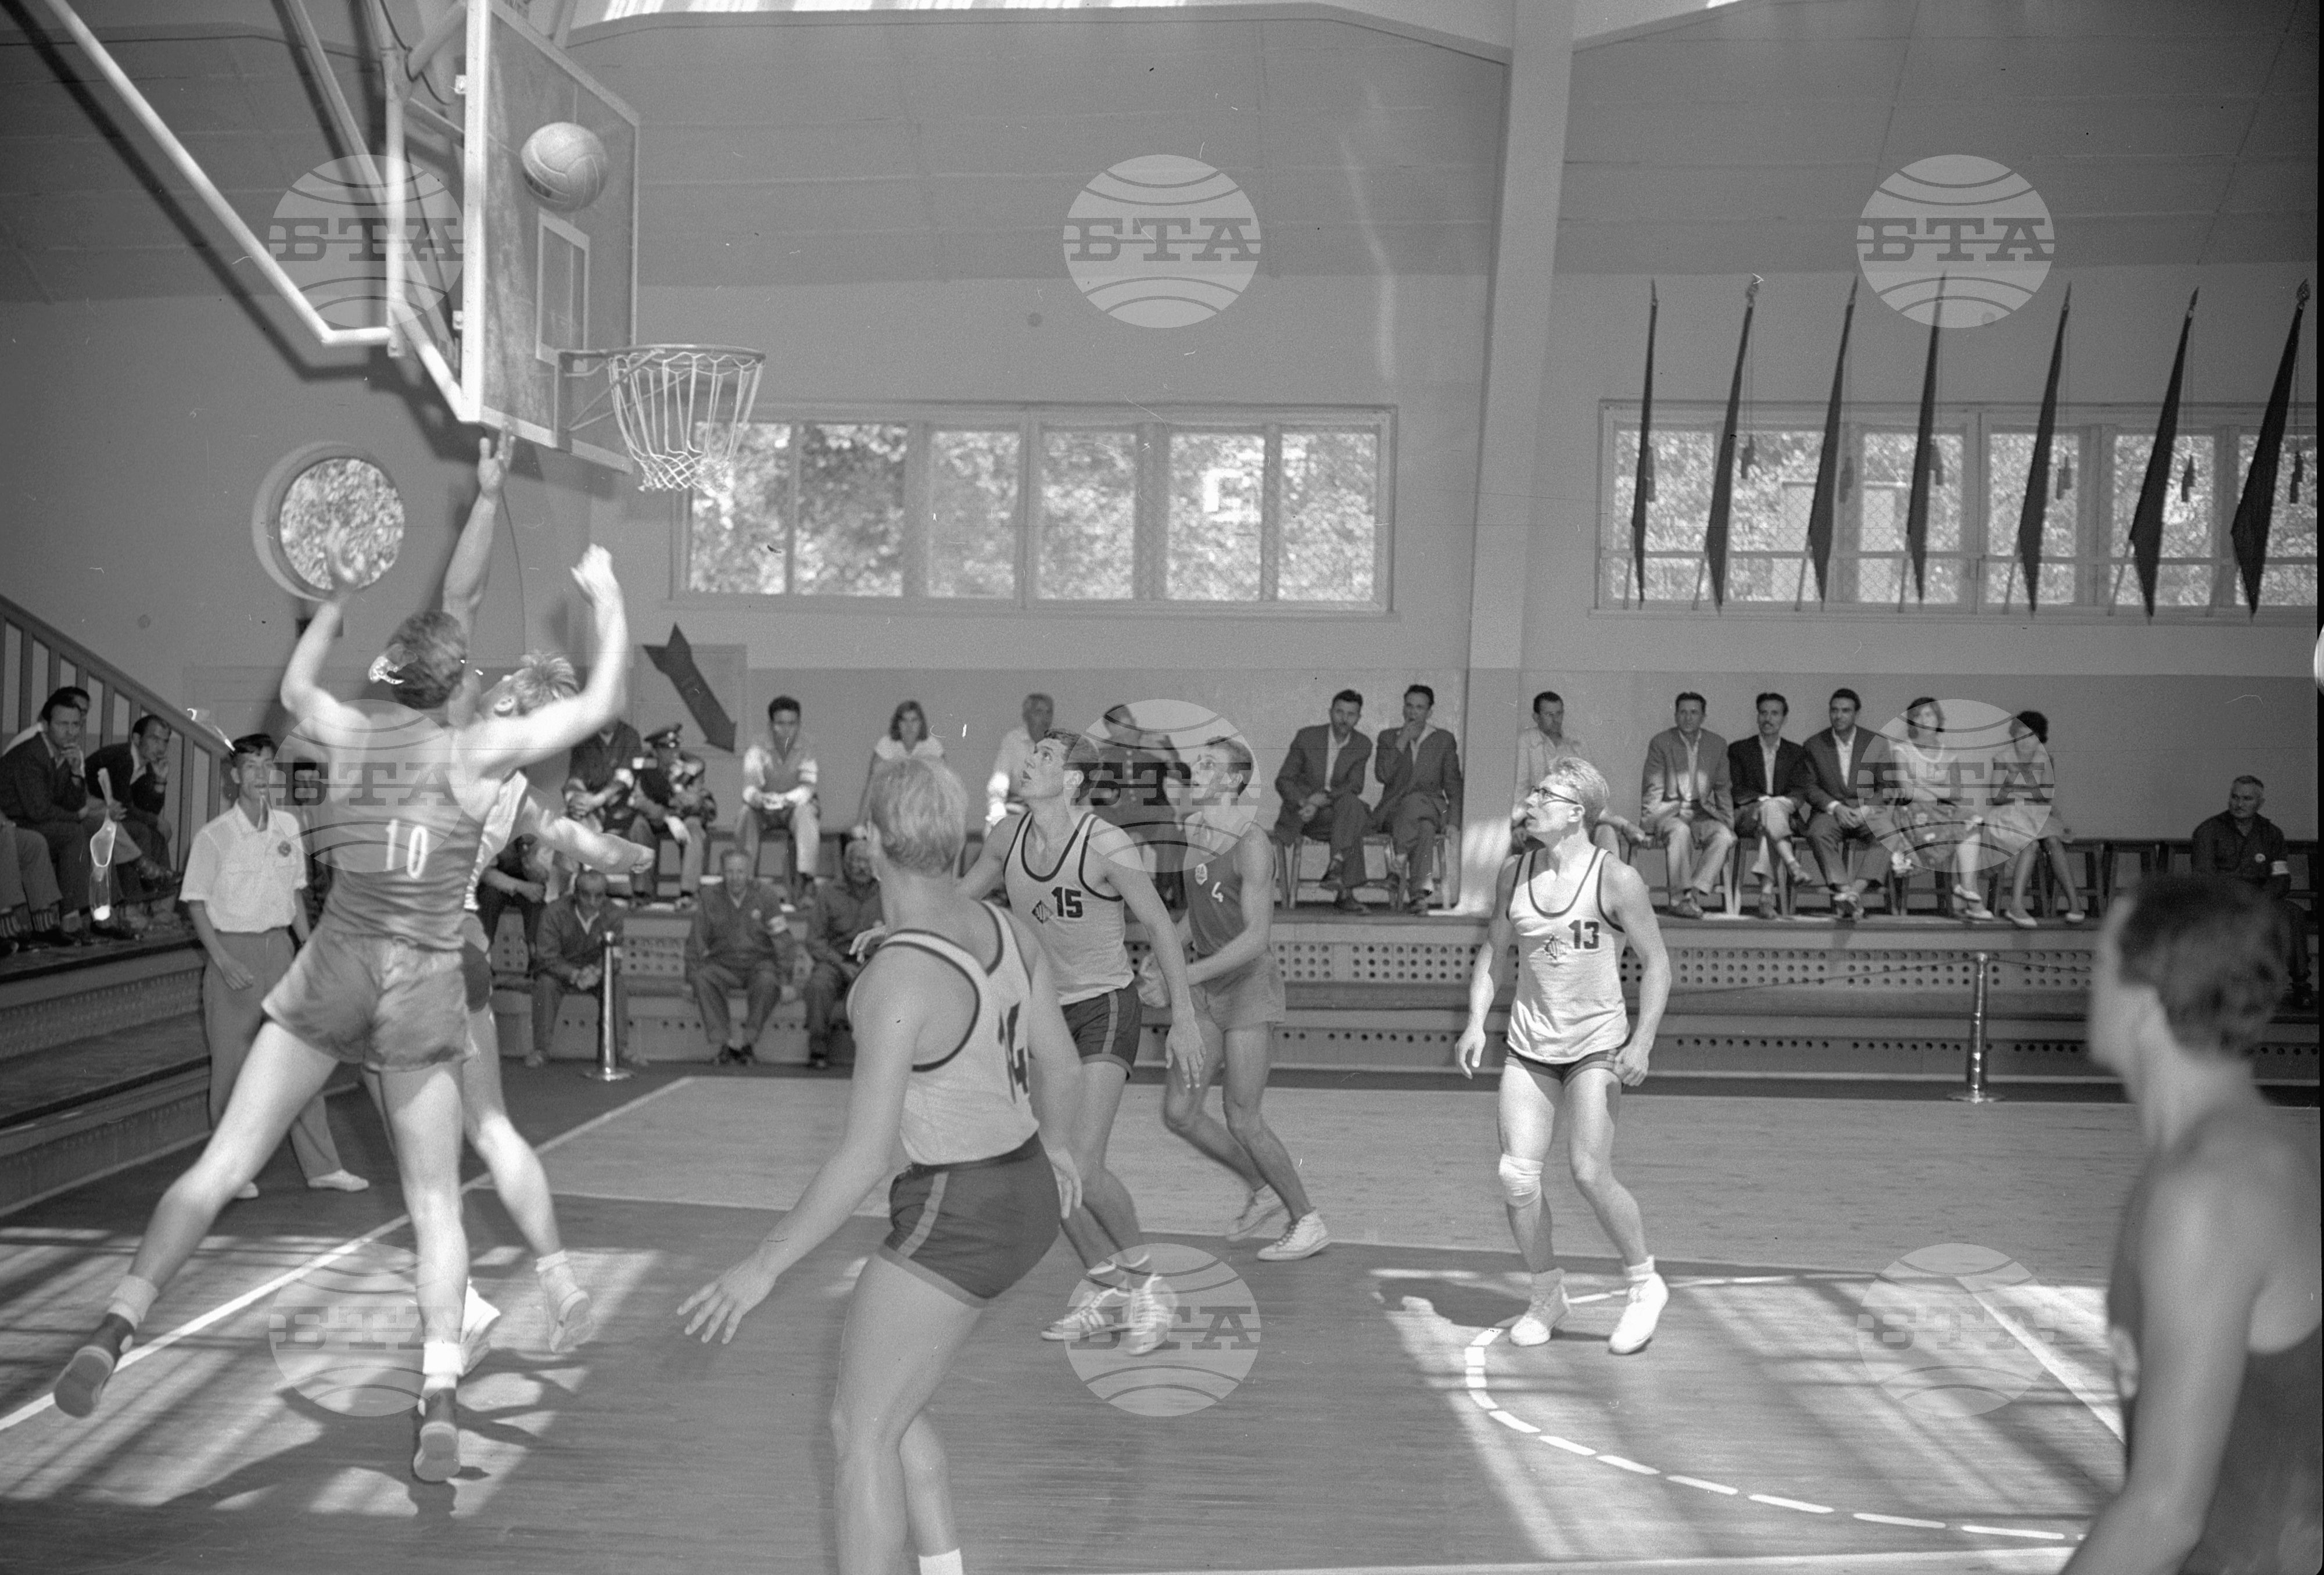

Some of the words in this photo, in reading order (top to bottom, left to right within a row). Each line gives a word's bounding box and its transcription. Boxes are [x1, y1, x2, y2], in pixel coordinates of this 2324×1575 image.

[385, 818, 429, 879] 10
[1052, 886, 1083, 918] 15
[1211, 881, 1224, 903] 4
[1568, 919, 1599, 950] 13
